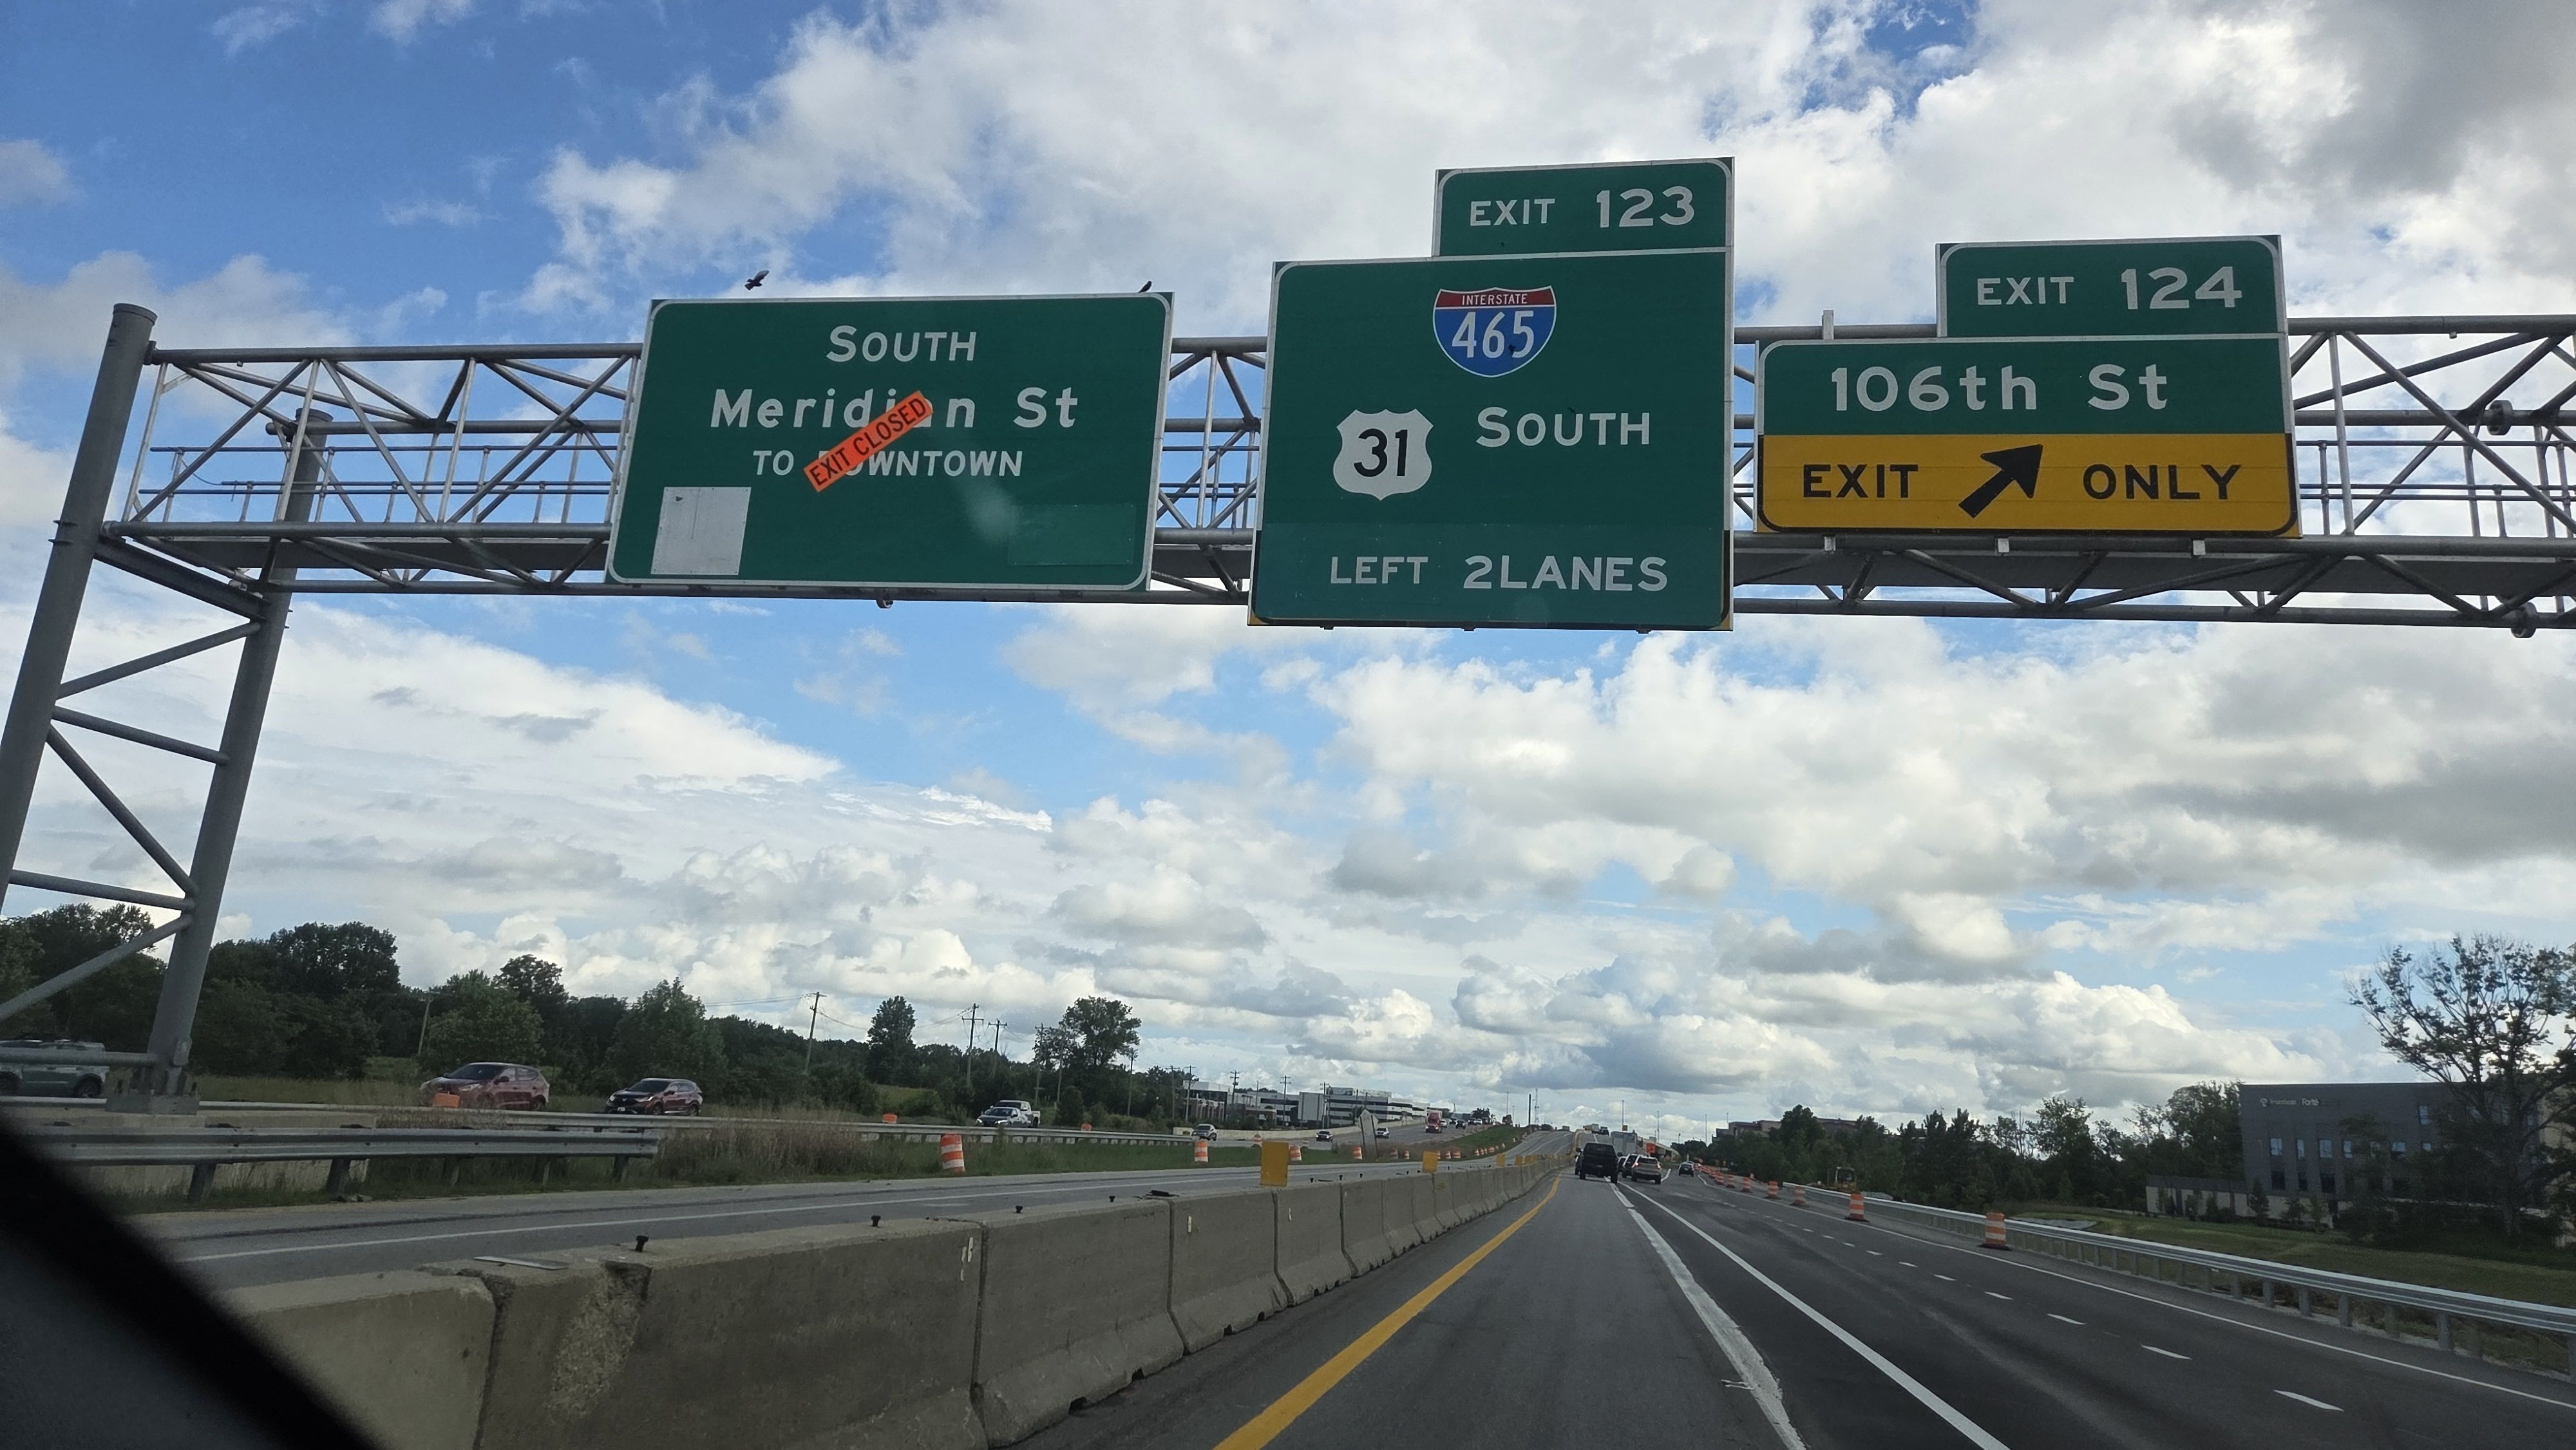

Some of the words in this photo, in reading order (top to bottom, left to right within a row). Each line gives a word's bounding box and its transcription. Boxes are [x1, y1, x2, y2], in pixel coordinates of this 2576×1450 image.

[1470, 198, 1555, 227] EXIT
[1596, 186, 1695, 228] 123
[1462, 294, 1528, 306] INTERSTATE
[1977, 276, 2074, 305] EXIT
[2121, 266, 2242, 310] 124
[826, 325, 977, 362] SOUTH
[1452, 310, 1535, 359] 465
[1013, 386, 1079, 428] St
[1832, 365, 2036, 411] 106th
[2088, 363, 2168, 411] St
[810, 447, 850, 486] EXIT
[853, 398, 926, 456] CLOSED
[1476, 406, 1651, 447] SOUTH
[753, 451, 794, 476] TO
[819, 451, 1023, 476] WNTOWN
[1353, 428, 1409, 477] 31
[1804, 464, 1919, 498] EXIT
[2083, 464, 2242, 500] ONLY
[1330, 556, 1428, 584] LEFT
